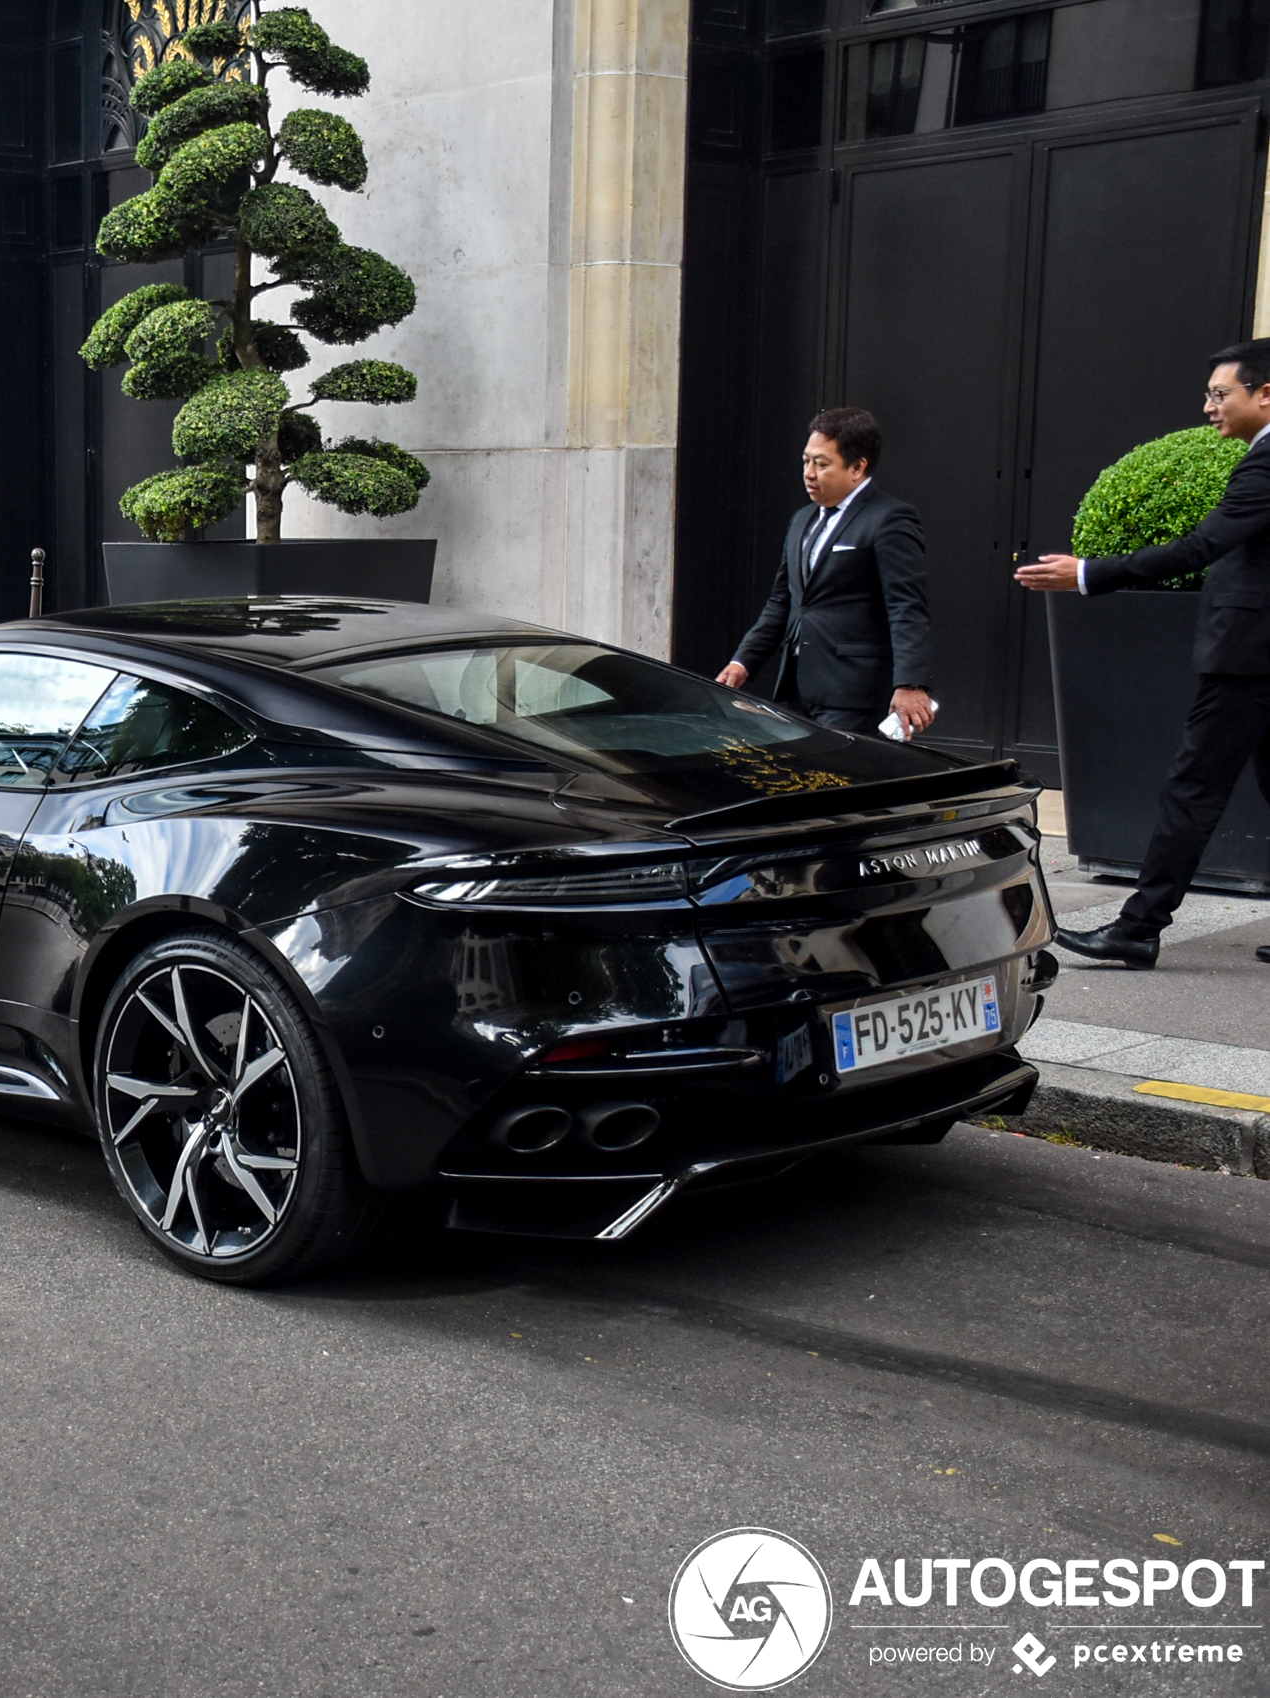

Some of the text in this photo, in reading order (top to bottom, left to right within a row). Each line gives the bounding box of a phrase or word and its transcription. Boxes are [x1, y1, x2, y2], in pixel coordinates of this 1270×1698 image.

[859, 840, 980, 877] ASTON MARTIN
[854, 986, 978, 1056] FD-525-KY
[985, 1008, 997, 1026] 75
